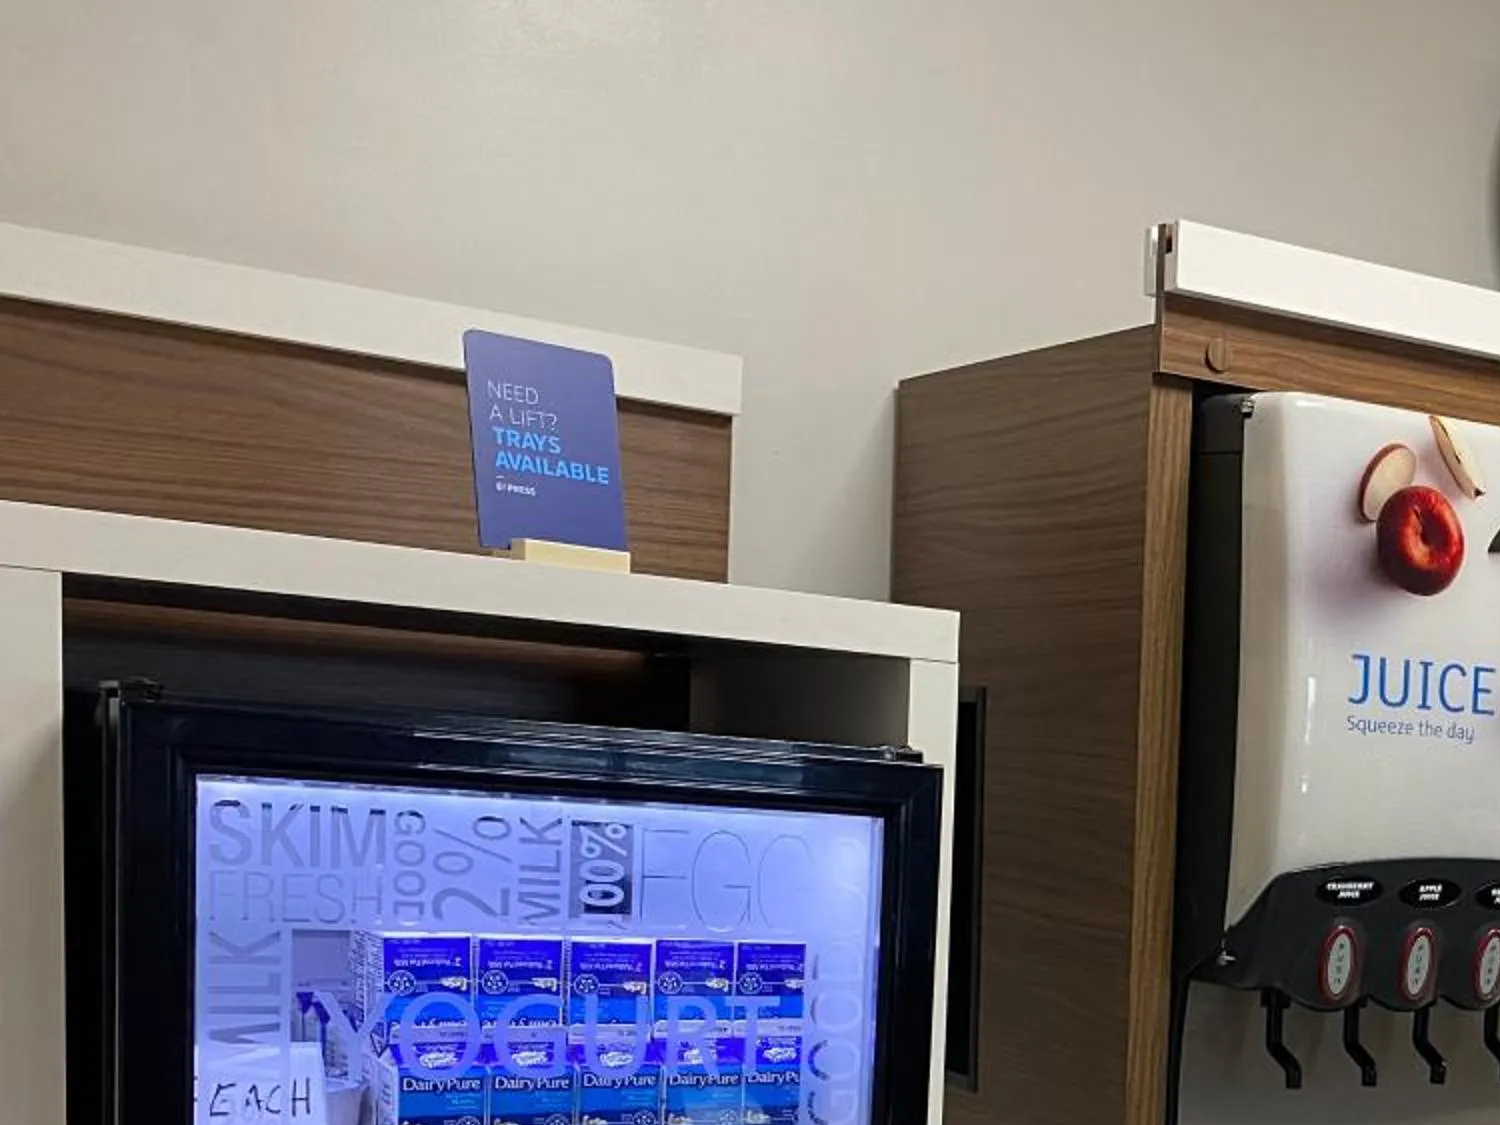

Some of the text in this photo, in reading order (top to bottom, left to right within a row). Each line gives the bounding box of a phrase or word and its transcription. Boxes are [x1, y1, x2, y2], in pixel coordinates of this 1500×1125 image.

[487, 379, 539, 406] NEED
[489, 403, 558, 432] A LIFT?
[491, 425, 561, 455] TRAYS
[495, 449, 609, 486] AVAILABLE
[1347, 653, 1497, 717] JUICE
[1346, 714, 1475, 745] Squeeze the day
[207, 799, 388, 870] SKIM
[431, 815, 512, 921] 2%
[517, 817, 564, 926] MILK
[208, 870, 384, 925] FRESH
[313, 989, 781, 1083] YOGURT
[209, 1076, 311, 1118] EACH
